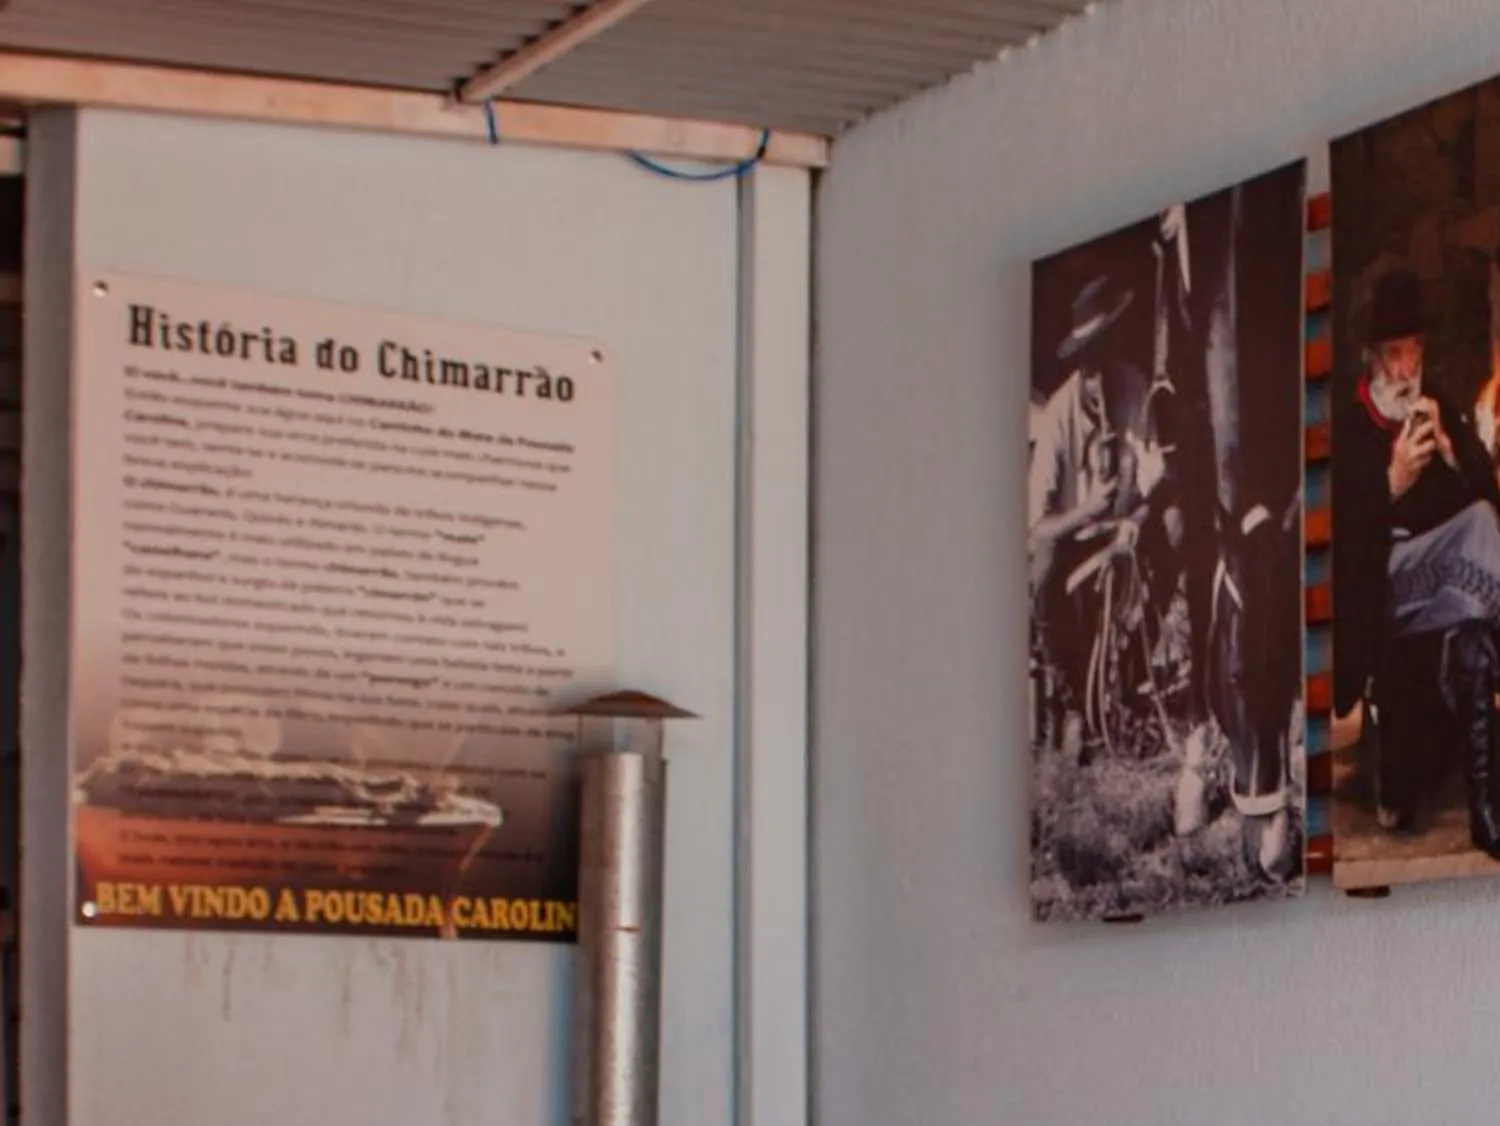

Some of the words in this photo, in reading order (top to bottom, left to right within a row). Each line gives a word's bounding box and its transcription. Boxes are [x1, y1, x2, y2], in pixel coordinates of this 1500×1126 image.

[126, 303, 299, 367] História
[314, 337, 359, 374] do
[377, 340, 575, 403] Chimarrão
[95, 881, 161, 917] BEM
[169, 884, 269, 922] VINDO
[274, 889, 299, 921] A
[305, 890, 445, 928] POUSADA
[450, 897, 577, 933] CAROLIN
